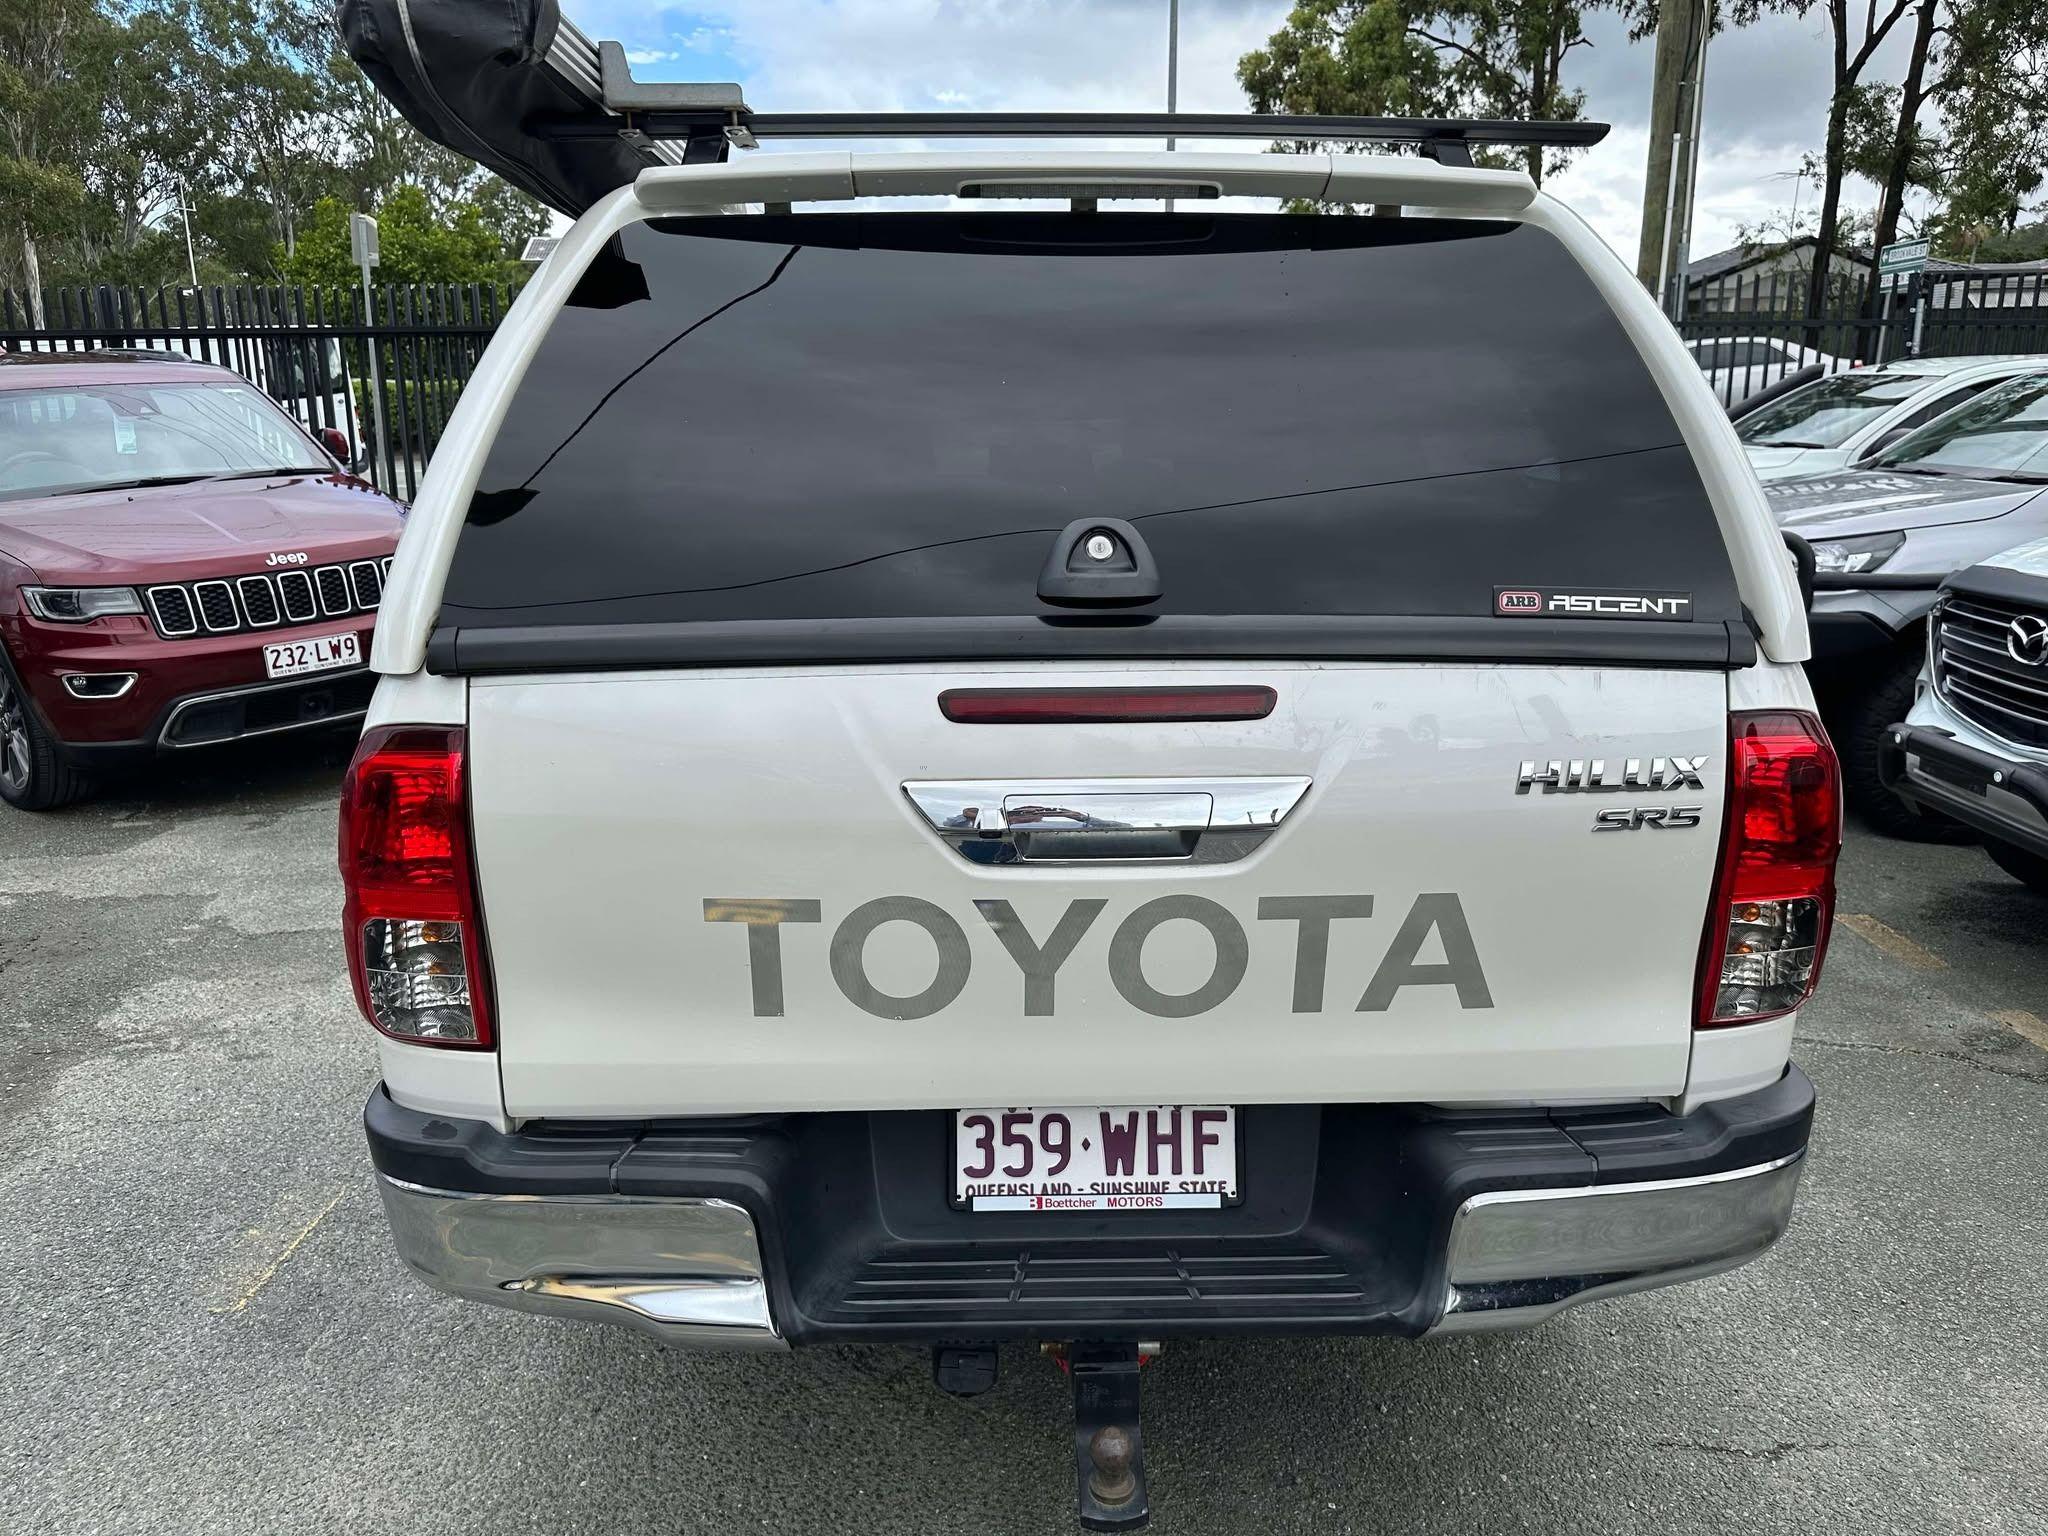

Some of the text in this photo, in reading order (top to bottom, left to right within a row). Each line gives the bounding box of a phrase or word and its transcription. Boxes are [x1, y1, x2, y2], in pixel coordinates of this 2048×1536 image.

[265, 552, 308, 566] Jeep
[1504, 595, 1688, 614] ARB ASCENT
[1516, 755, 1709, 794] HILUX
[1591, 805, 1703, 832] SR5
[703, 893, 1494, 1020] TOYOTA
[965, 1183, 1072, 1196] QUEENSLAND
[1090, 1181, 1170, 1194] SUNSHINE
[1179, 1180, 1227, 1193] STATE
[1107, 1196, 1163, 1208] MOTORS
